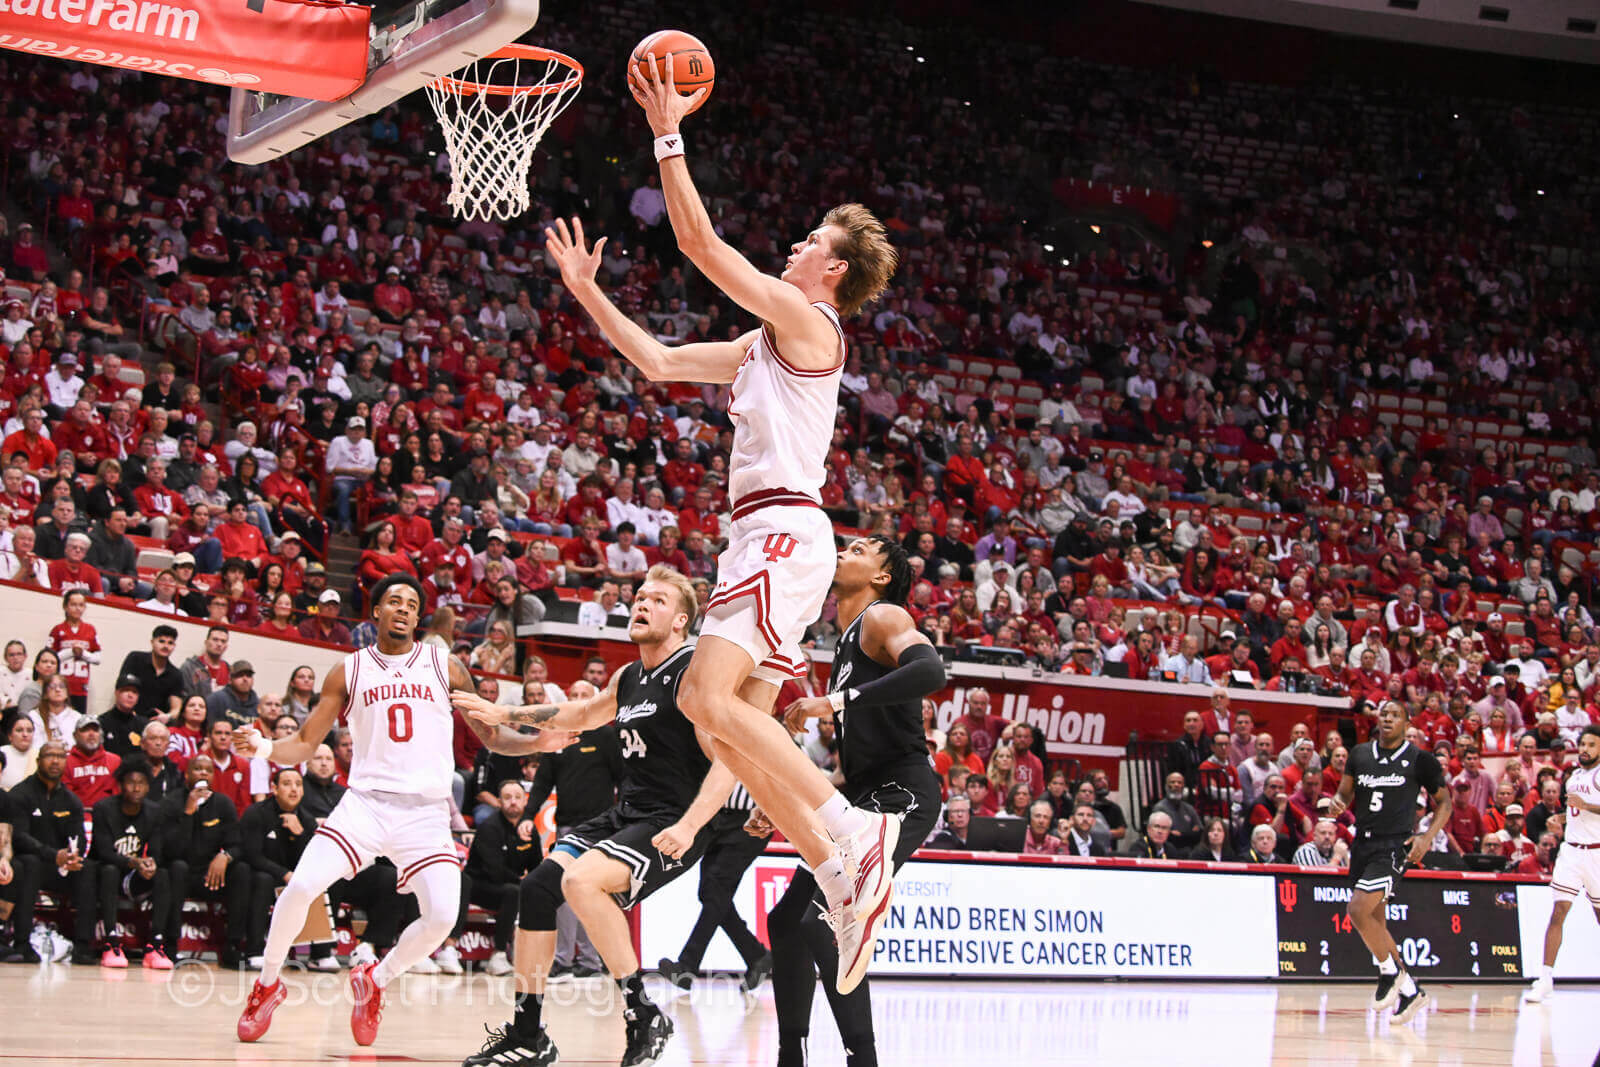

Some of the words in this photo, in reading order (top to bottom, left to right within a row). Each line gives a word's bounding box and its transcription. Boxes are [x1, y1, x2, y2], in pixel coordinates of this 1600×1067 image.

[363, 683, 435, 707] INDIANA
[387, 703, 413, 743] 0
[1001, 693, 1106, 745] Union
[620, 729, 647, 759] 34
[1369, 792, 1384, 812] 5
[1443, 890, 1470, 906] MKE
[913, 906, 961, 930] AND
[969, 908, 1026, 932] BREN
[1034, 909, 1104, 933] SIMON
[1332, 913, 1352, 934] 14
[1451, 914, 1461, 934] 8
[873, 938, 1014, 965] PREHENSIVE
[1021, 941, 1107, 966] CANCER
[1114, 943, 1192, 967] CENTER
[1278, 942, 1306, 953] FOULS
[1320, 940, 1329, 956] 2
[1470, 941, 1479, 956] 3
[1492, 945, 1517, 957] FOULS
[1279, 961, 1296, 972] TOL
[1320, 960, 1330, 976] 4
[1472, 961, 1480, 976] 4
[1503, 963, 1518, 974] TOL
